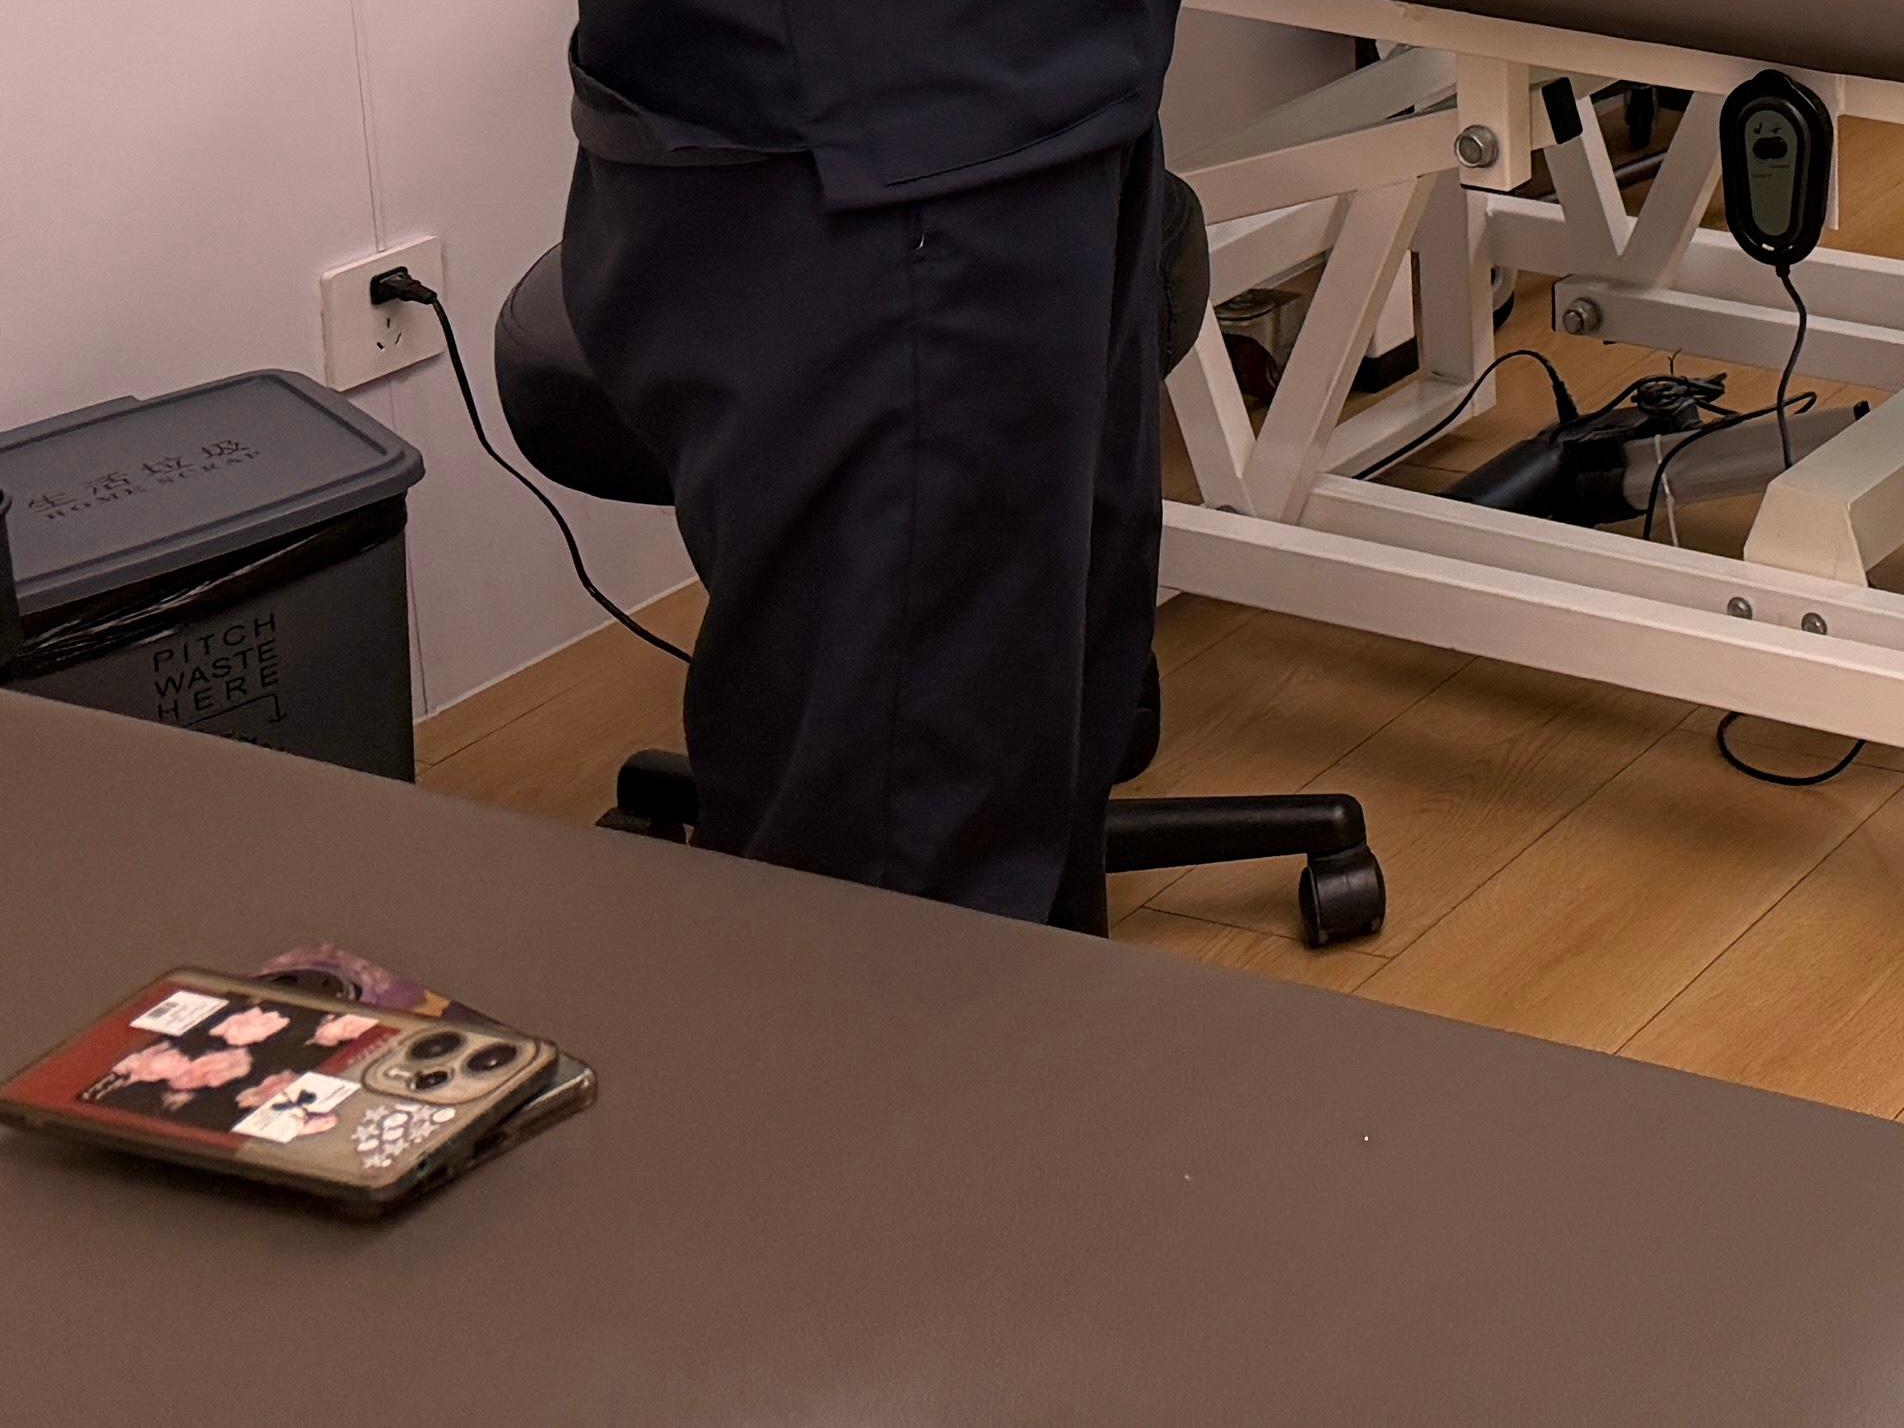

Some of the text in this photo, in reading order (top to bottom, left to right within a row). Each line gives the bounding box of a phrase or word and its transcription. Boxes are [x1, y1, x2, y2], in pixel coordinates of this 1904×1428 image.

[153, 612, 276, 673] PITCH
[154, 638, 279, 698] WASTE
[158, 663, 279, 720] HERE
